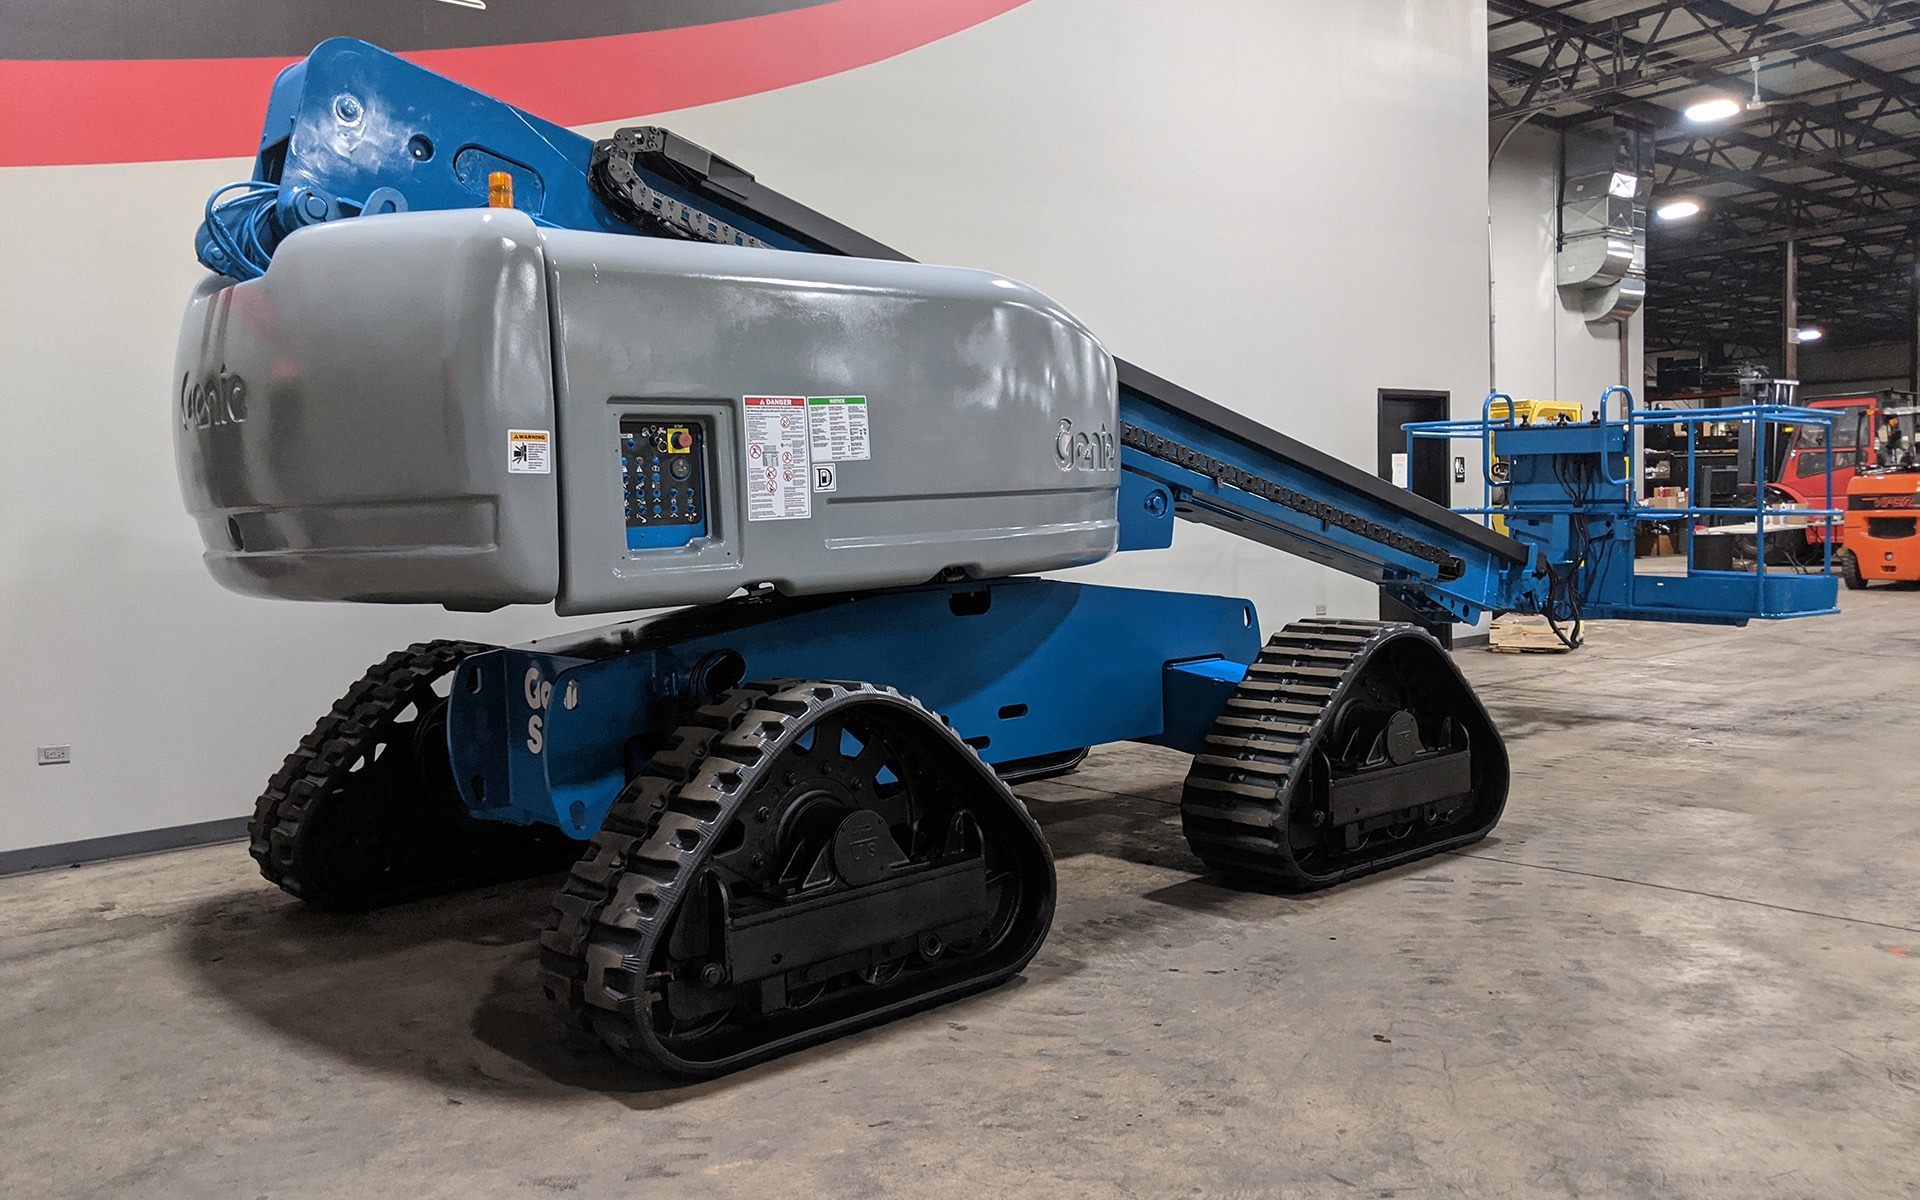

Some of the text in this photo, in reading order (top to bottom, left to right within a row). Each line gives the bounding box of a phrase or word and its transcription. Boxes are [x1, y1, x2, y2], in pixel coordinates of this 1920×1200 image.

[1054, 417, 1115, 471] Genie
[816, 468, 833, 488] D
[1862, 496, 1919, 508] VIPER
